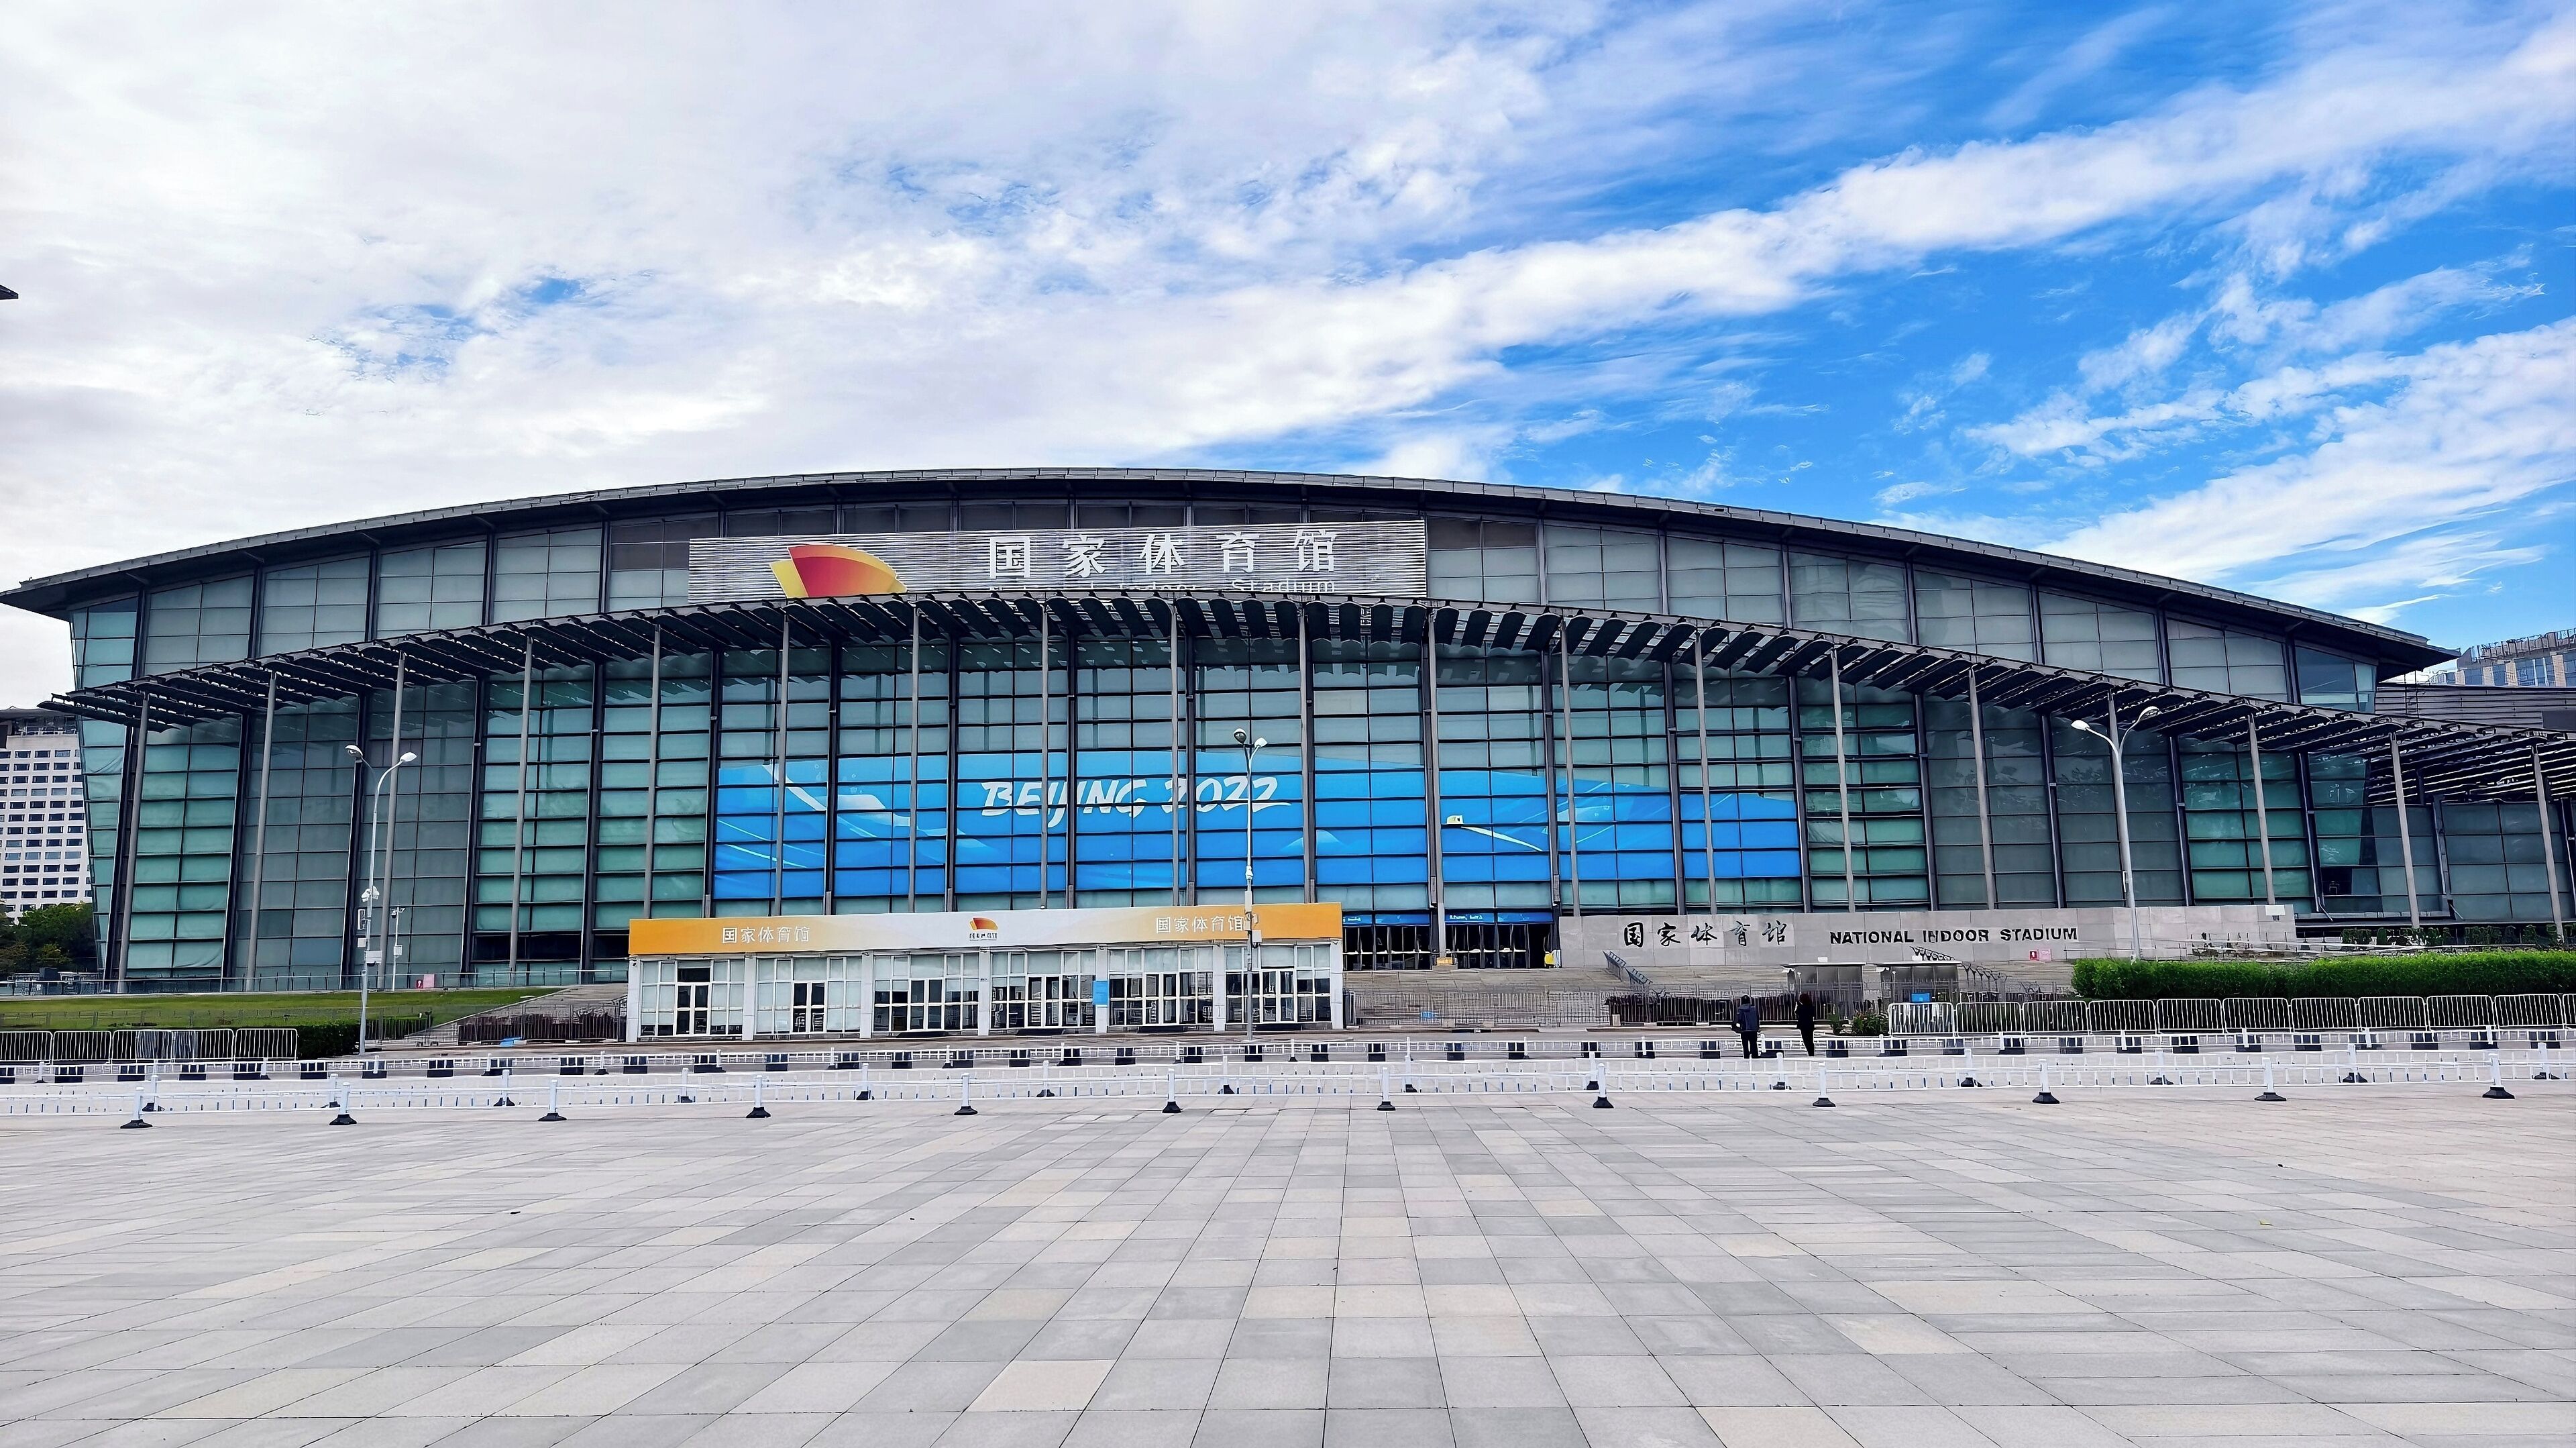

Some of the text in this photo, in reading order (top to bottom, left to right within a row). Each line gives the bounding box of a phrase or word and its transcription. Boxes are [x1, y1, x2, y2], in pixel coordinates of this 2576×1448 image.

[989, 529, 1339, 579] 国家体育馆
[1232, 578, 1336, 593] Stadium
[980, 776, 1292, 828] BEIJING 2022
[1155, 915, 1244, 934] 国家体育馆
[1623, 920, 1788, 948] 国家体育馆
[722, 926, 810, 944] 国家体育馆
[1829, 927, 2078, 945] NATIONAL INDOOR STADIUM
